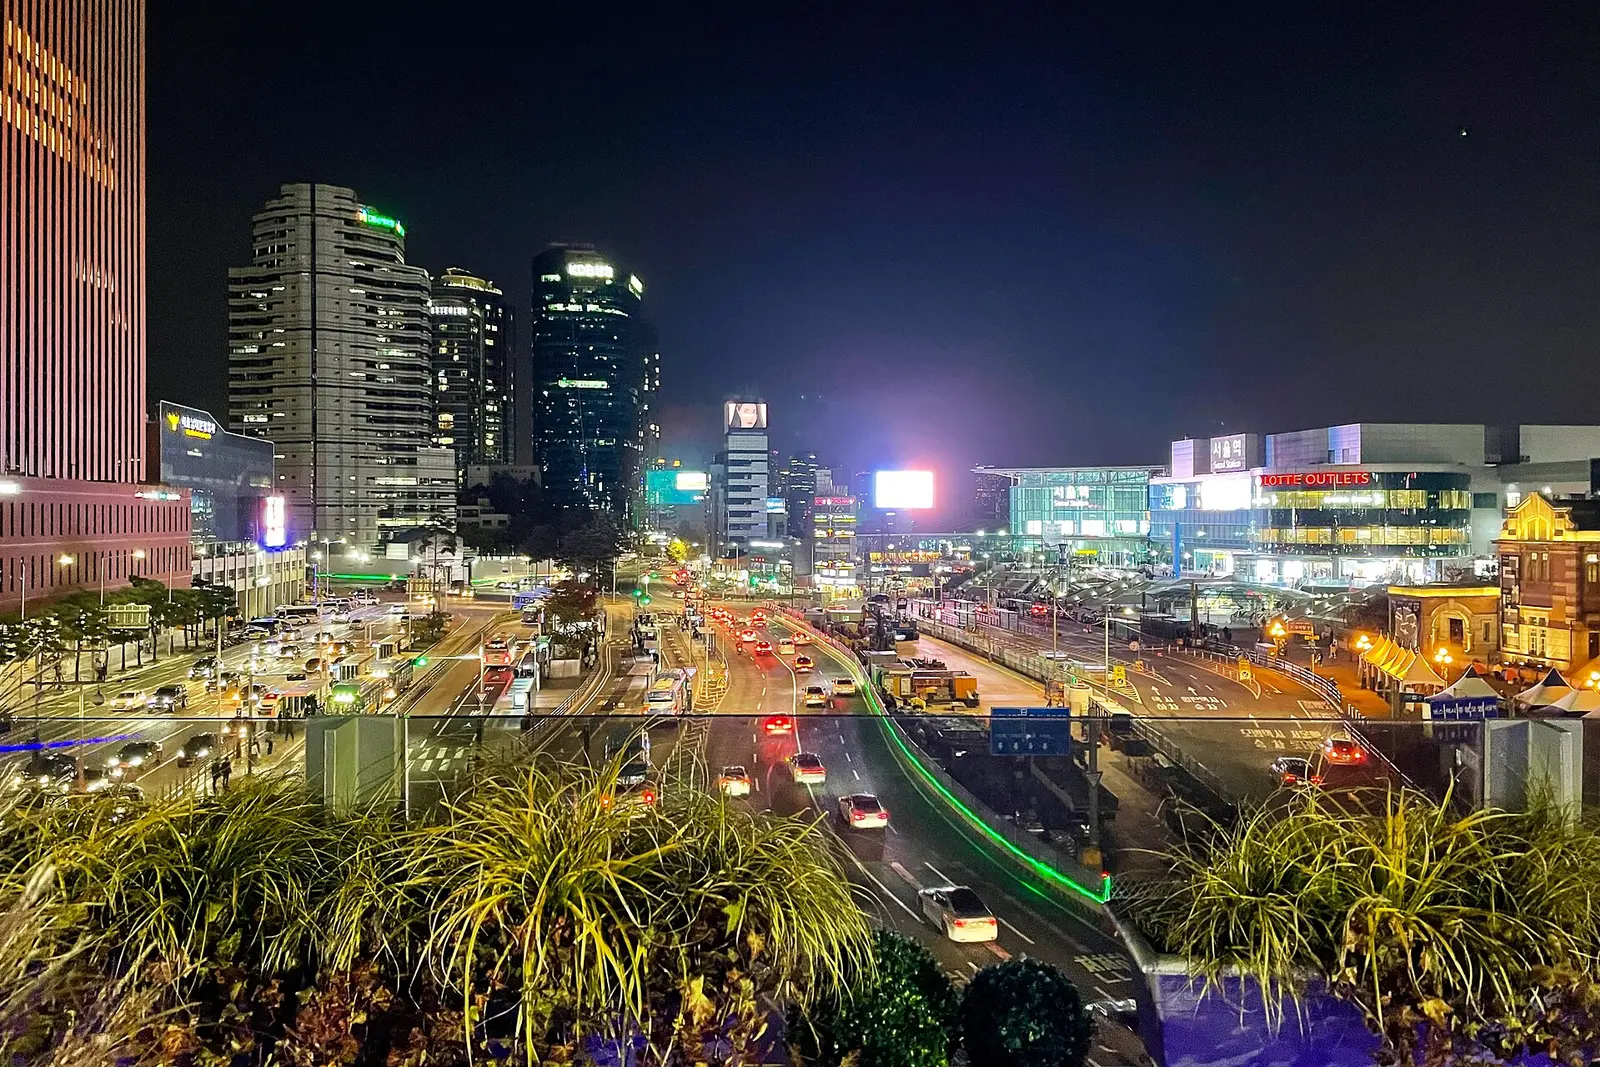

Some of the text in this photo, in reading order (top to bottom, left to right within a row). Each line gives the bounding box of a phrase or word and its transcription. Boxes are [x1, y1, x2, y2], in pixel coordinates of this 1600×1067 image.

[1213, 440, 1242, 459] 서울역
[1213, 459, 1242, 469] Seoul Station
[1264, 473, 1369, 486] LOTTE OUTLETS
[1054, 485, 1089, 499] 서울역
